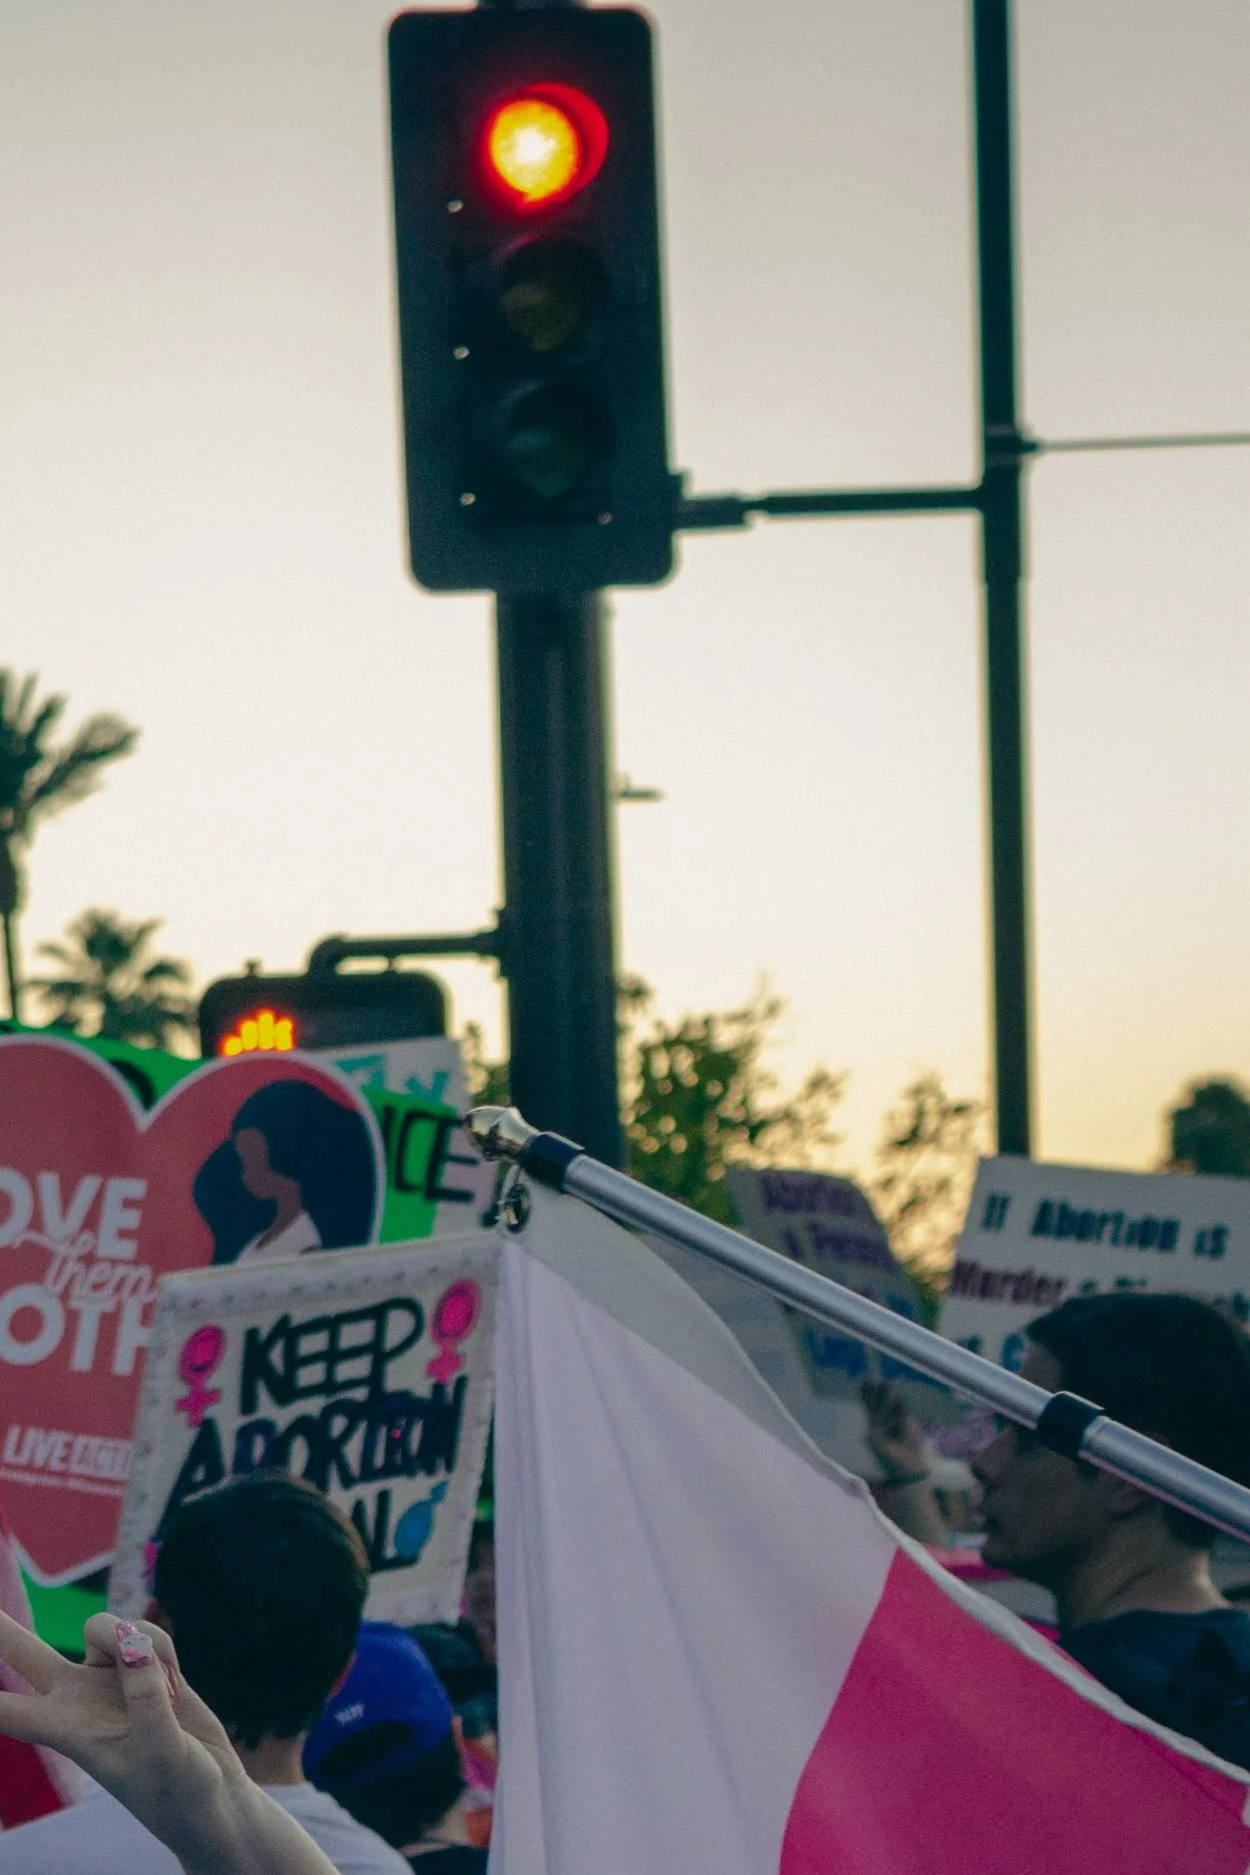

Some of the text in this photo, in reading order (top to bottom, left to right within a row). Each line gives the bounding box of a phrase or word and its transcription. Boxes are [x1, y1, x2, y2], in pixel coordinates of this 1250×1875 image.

[1031, 1199, 1180, 1252] Abortion
[14, 1228, 157, 1303] them
[240, 1297, 426, 1415] KEEP
[3, 1424, 72, 1471] LIVE
